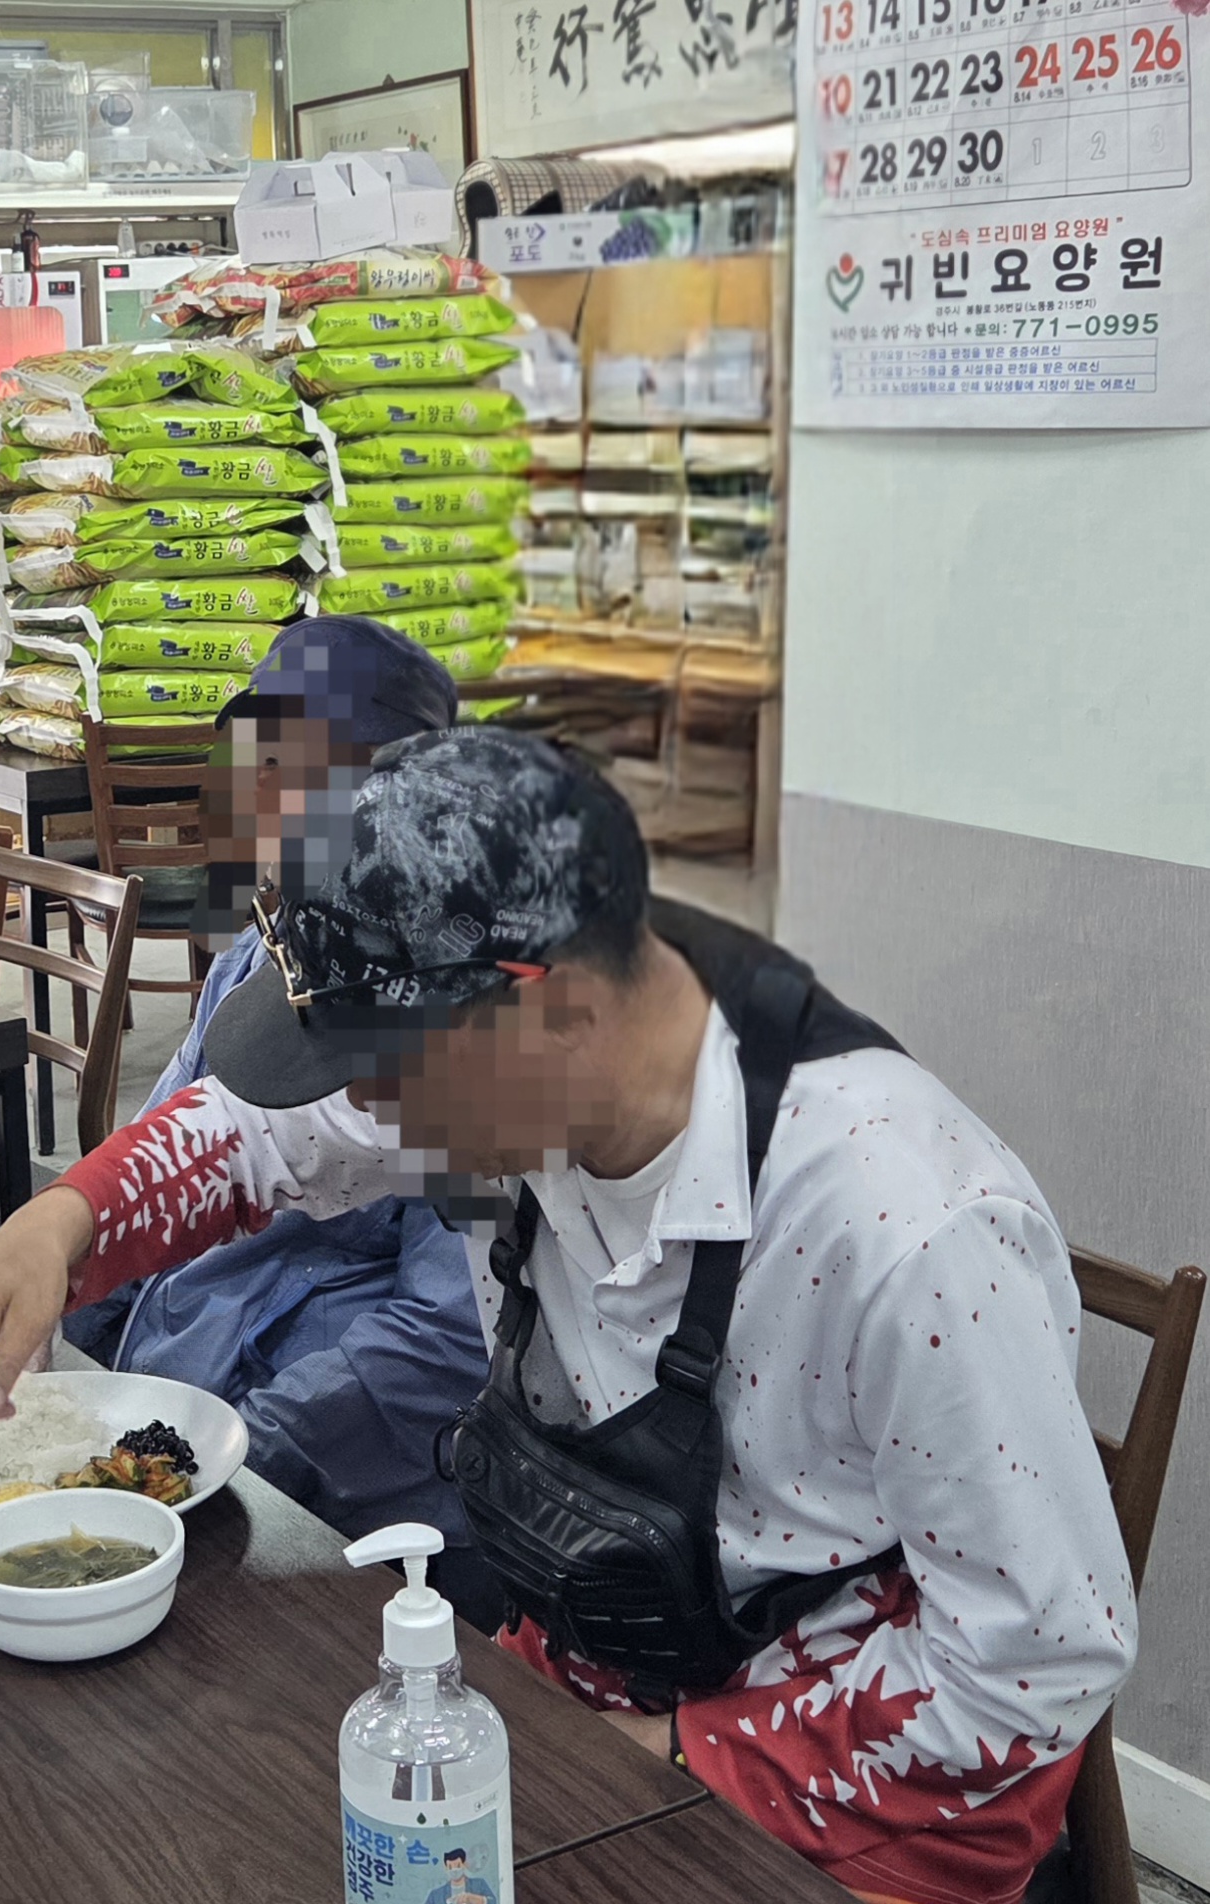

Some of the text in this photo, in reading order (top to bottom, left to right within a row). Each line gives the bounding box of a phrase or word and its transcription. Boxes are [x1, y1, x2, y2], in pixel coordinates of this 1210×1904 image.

[823, 1, 853, 42] 13
[868, 0, 900, 33] 14
[863, 67, 896, 110] 21
[910, 59, 949, 103] 22
[959, 50, 1003, 96] 23
[1015, 43, 1061, 88] 24
[1072, 34, 1119, 81] 25
[1131, 25, 1181, 73] 26
[860, 141, 897, 183] 28
[907, 136, 947, 179] 29
[958, 129, 1003, 174] 30
[1090, 130, 1106, 161] 2
[977, 222, 1047, 244] 프리미엄
[509, 244, 542, 261] 포도
[880, 236, 1163, 301] 귀빈요양원
[1012, 313, 1159, 338] 771-0995
[1068, 361, 1100, 373] 어르신
[1101, 378, 1136, 390] 어르신
